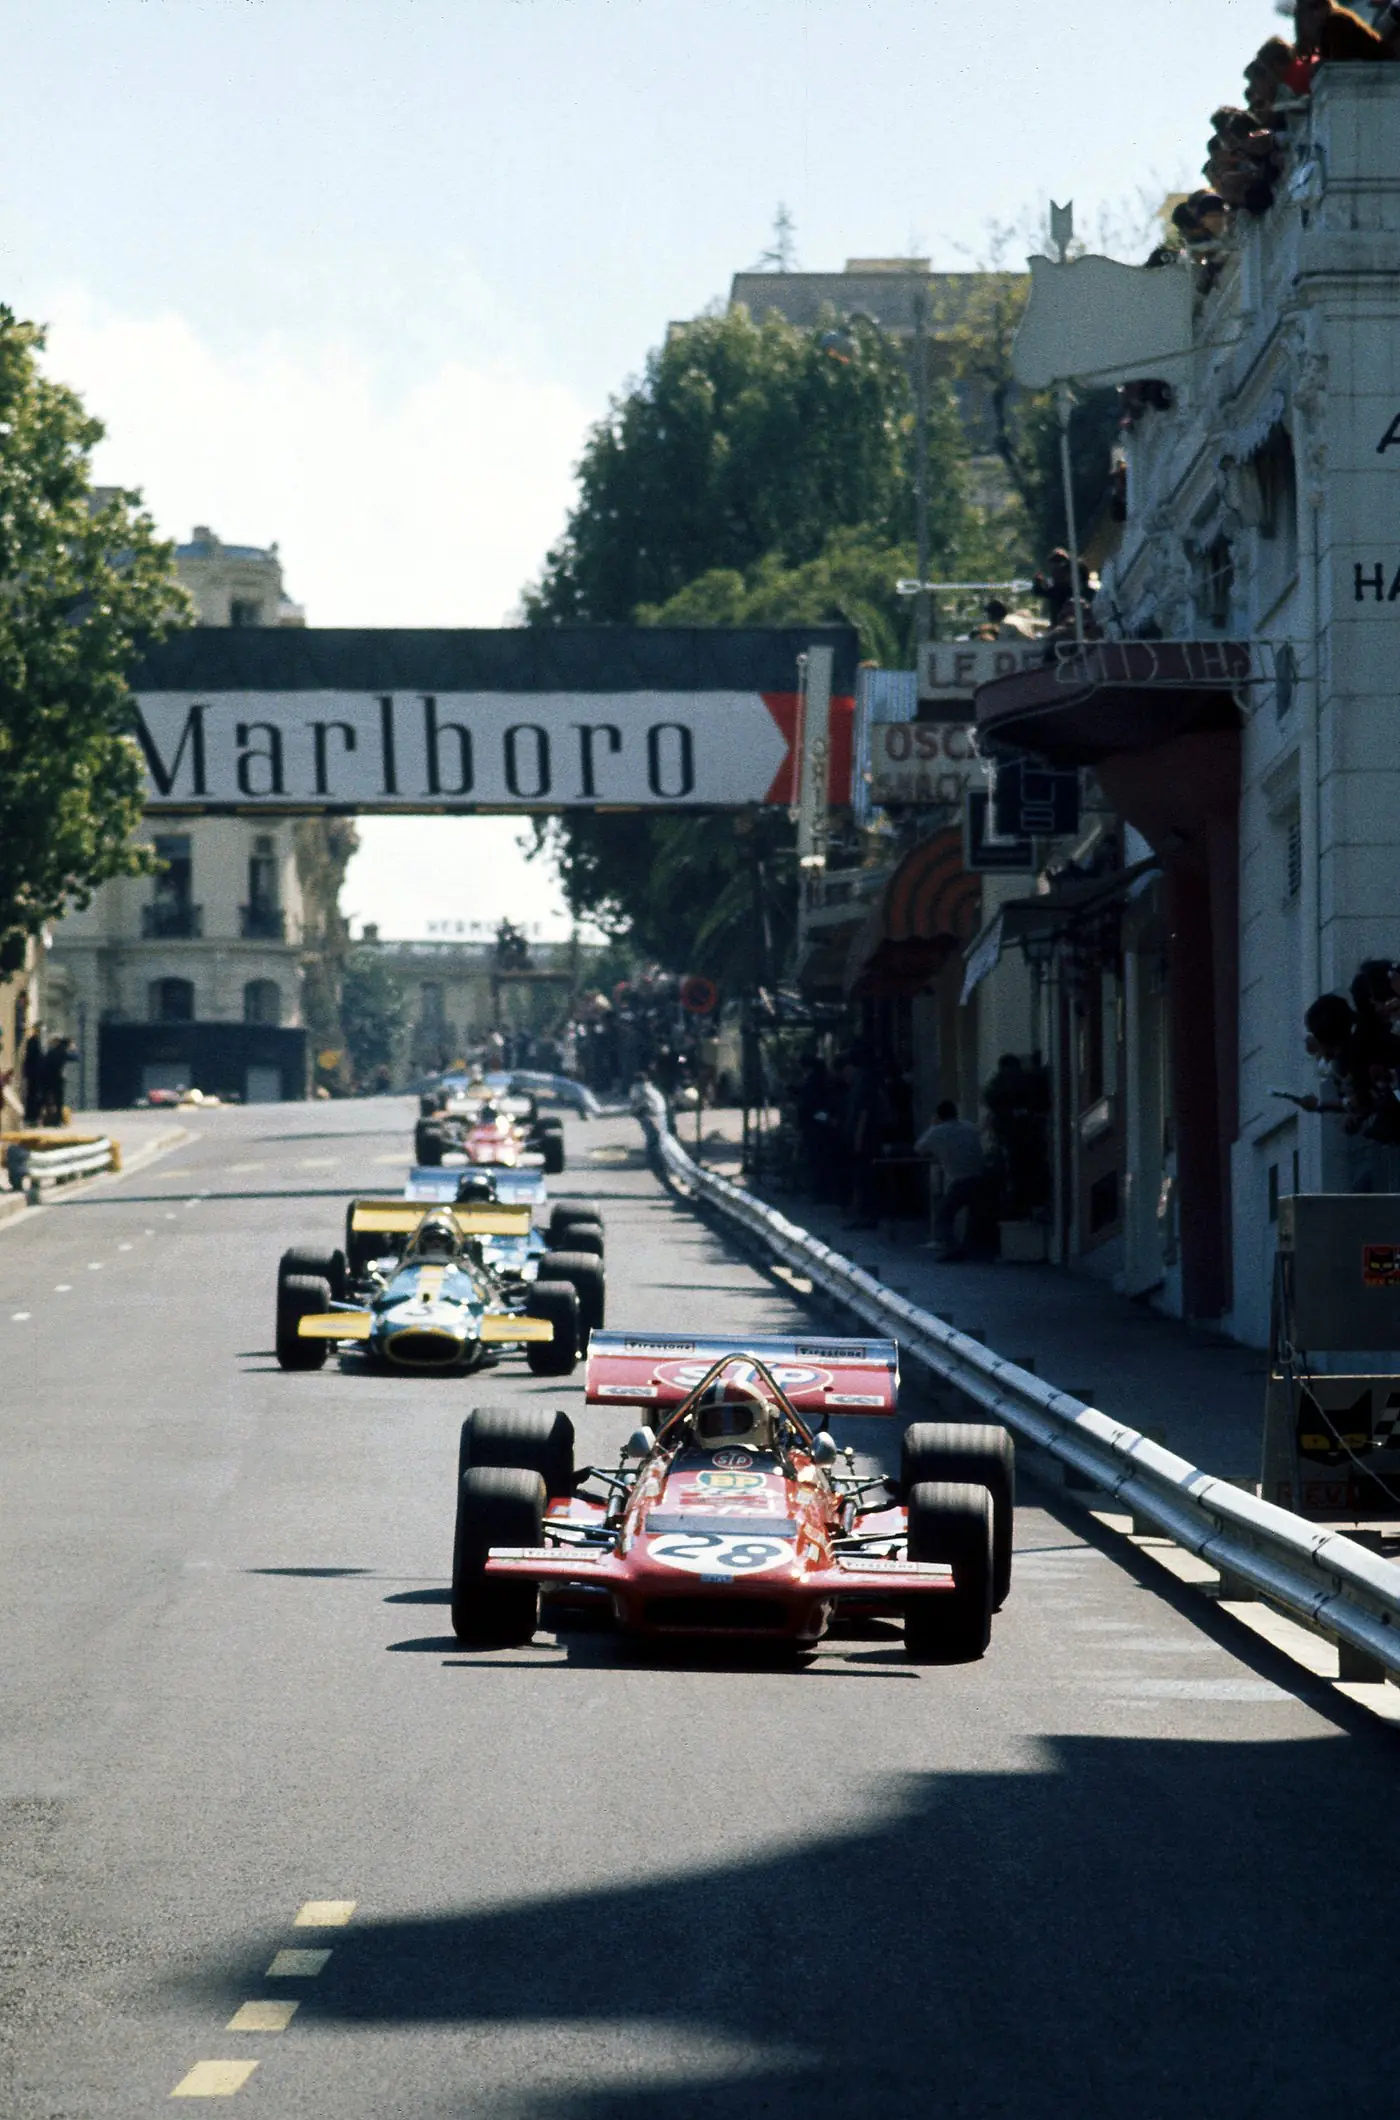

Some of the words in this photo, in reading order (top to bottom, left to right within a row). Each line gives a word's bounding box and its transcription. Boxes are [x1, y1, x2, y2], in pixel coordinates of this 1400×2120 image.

[928, 651, 978, 689] LE
[129, 694, 697, 800] Marlboro
[628, 1341, 692, 1351] Firestone
[799, 1347, 862, 1359] Firestone
[717, 1453, 750, 1467] STP
[709, 1473, 763, 1488] BP
[655, 1533, 782, 1568] 28
